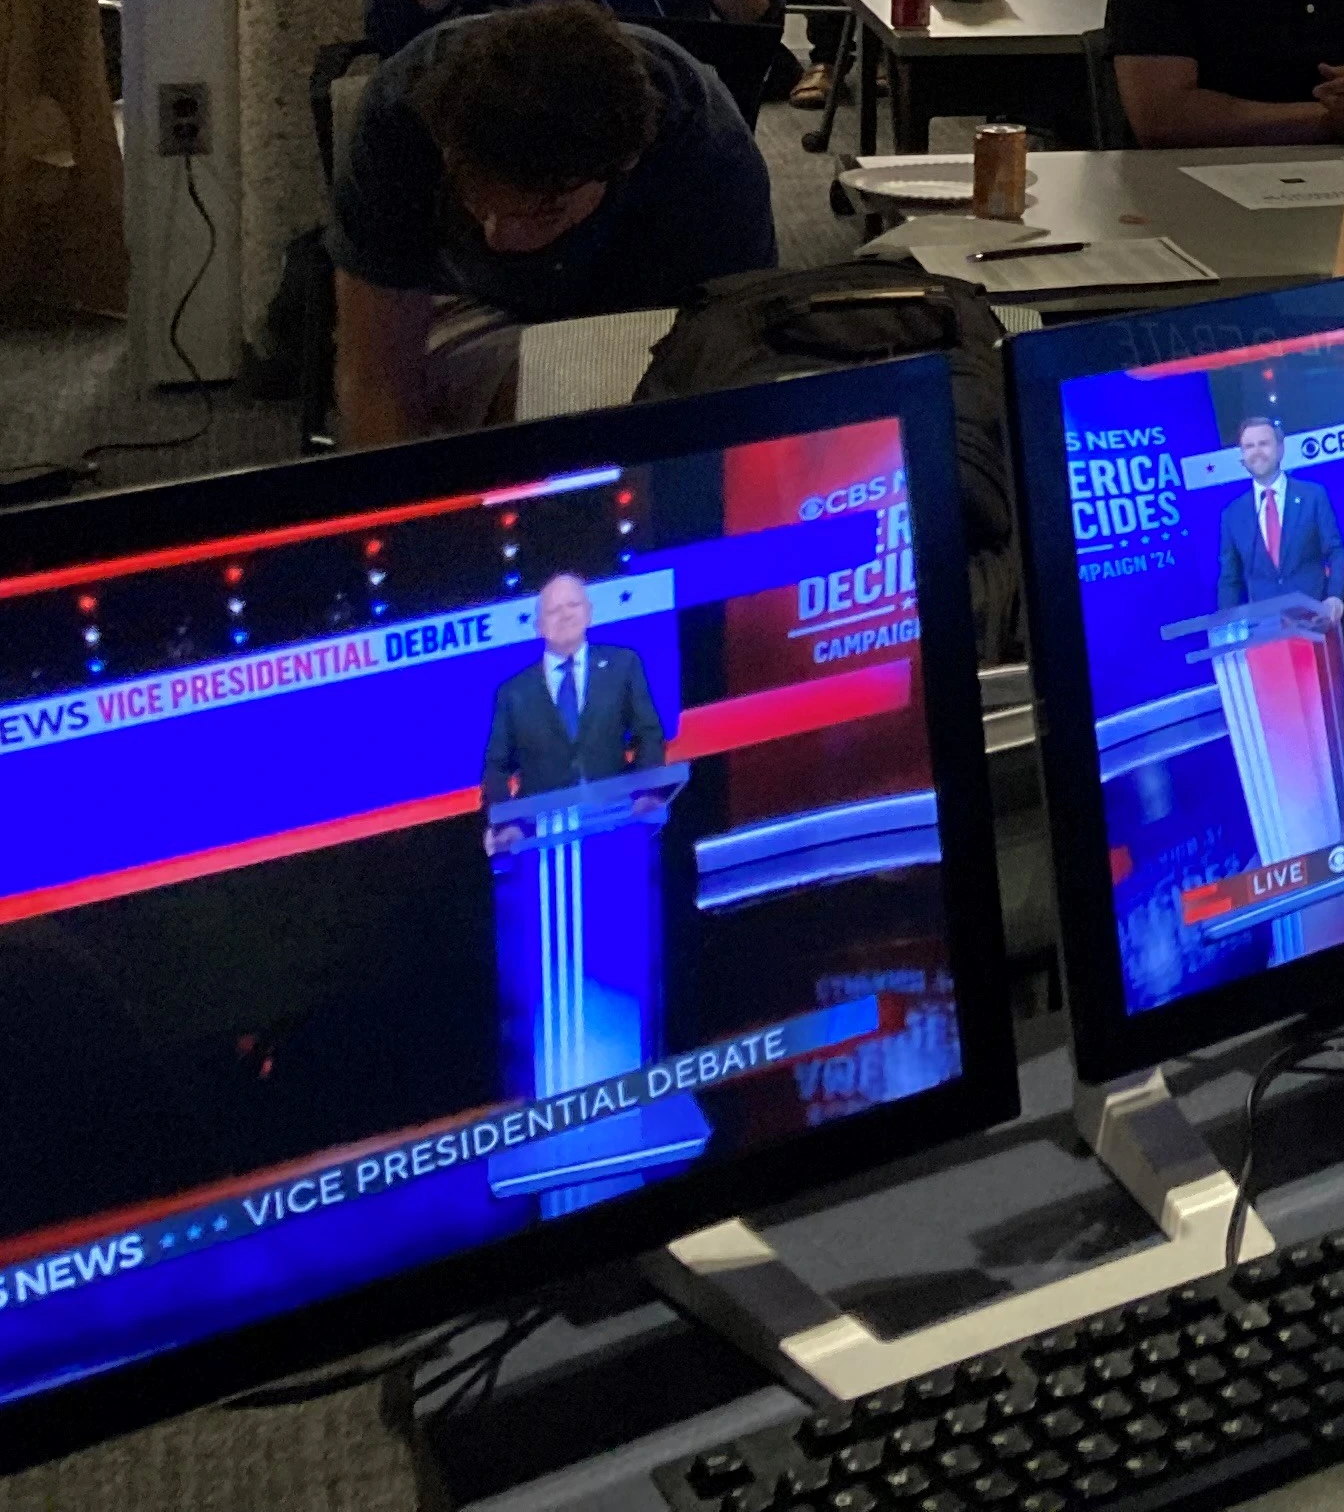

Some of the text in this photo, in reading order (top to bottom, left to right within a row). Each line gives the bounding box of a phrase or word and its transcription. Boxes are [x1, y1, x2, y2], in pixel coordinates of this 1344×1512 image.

[1084, 426, 1166, 451] NEWS
[825, 475, 888, 515] CBS
[1068, 452, 1182, 500] ERICA
[1072, 490, 1181, 540] CIDES
[798, 548, 917, 621] DECI
[813, 616, 921, 665] CAMPAIG
[0, 613, 493, 746] EWS VICE PRESIDENTIAL DEBATE
[1252, 861, 1304, 896] LIVE
[14, 1231, 145, 1303] NEWS
[241, 1168, 347, 1228] VICE
[356, 1080, 640, 1194] PRESIDENTIAL
[646, 1026, 787, 1099] DEBATE
